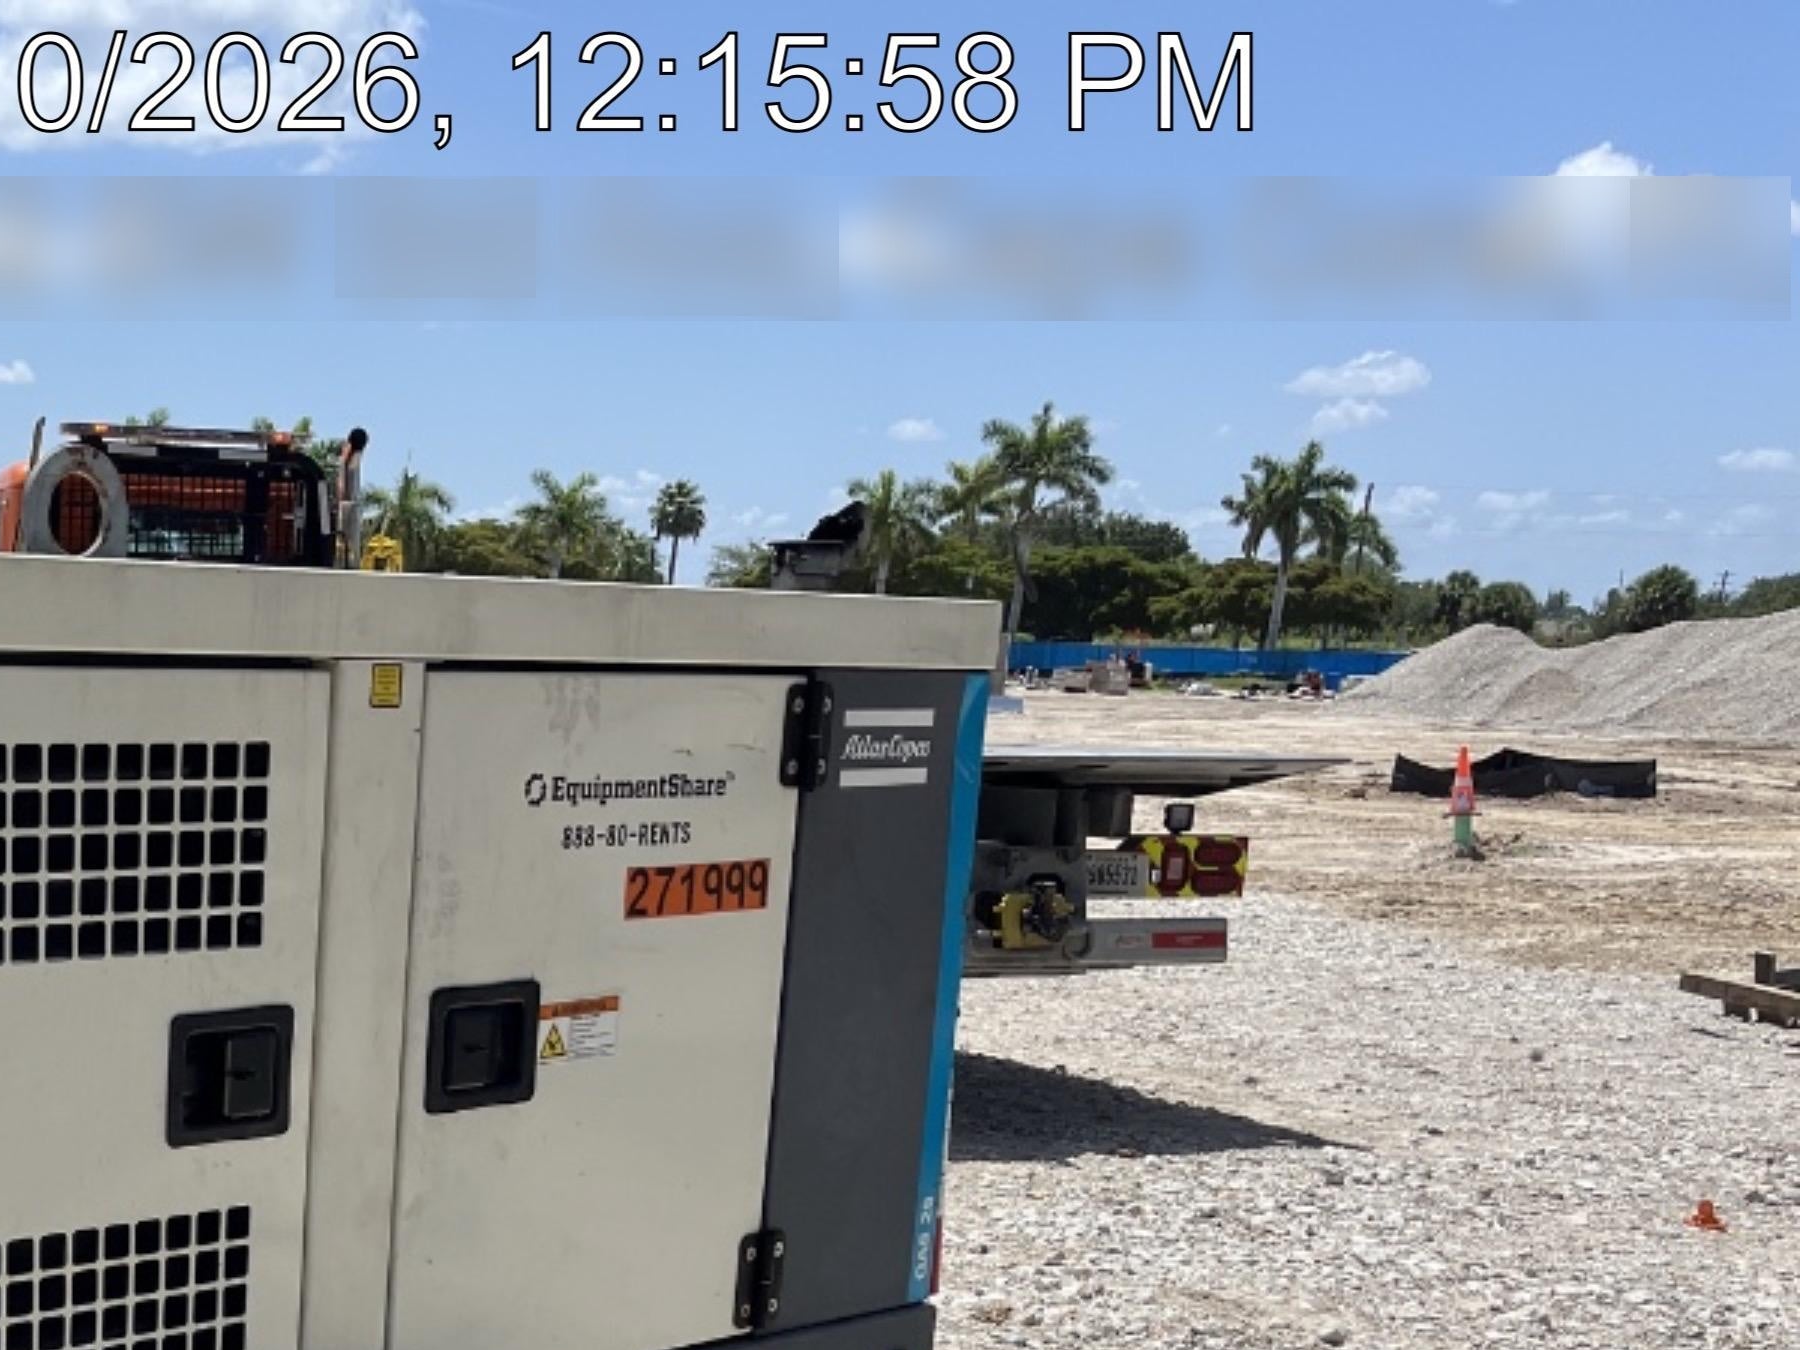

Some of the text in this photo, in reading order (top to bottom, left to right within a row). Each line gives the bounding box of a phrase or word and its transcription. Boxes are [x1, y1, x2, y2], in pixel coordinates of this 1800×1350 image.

[551, 772, 727, 807] EquipmentShare
[561, 822, 692, 850] 888-80-RENTS
[626, 860, 769, 917] 271999
